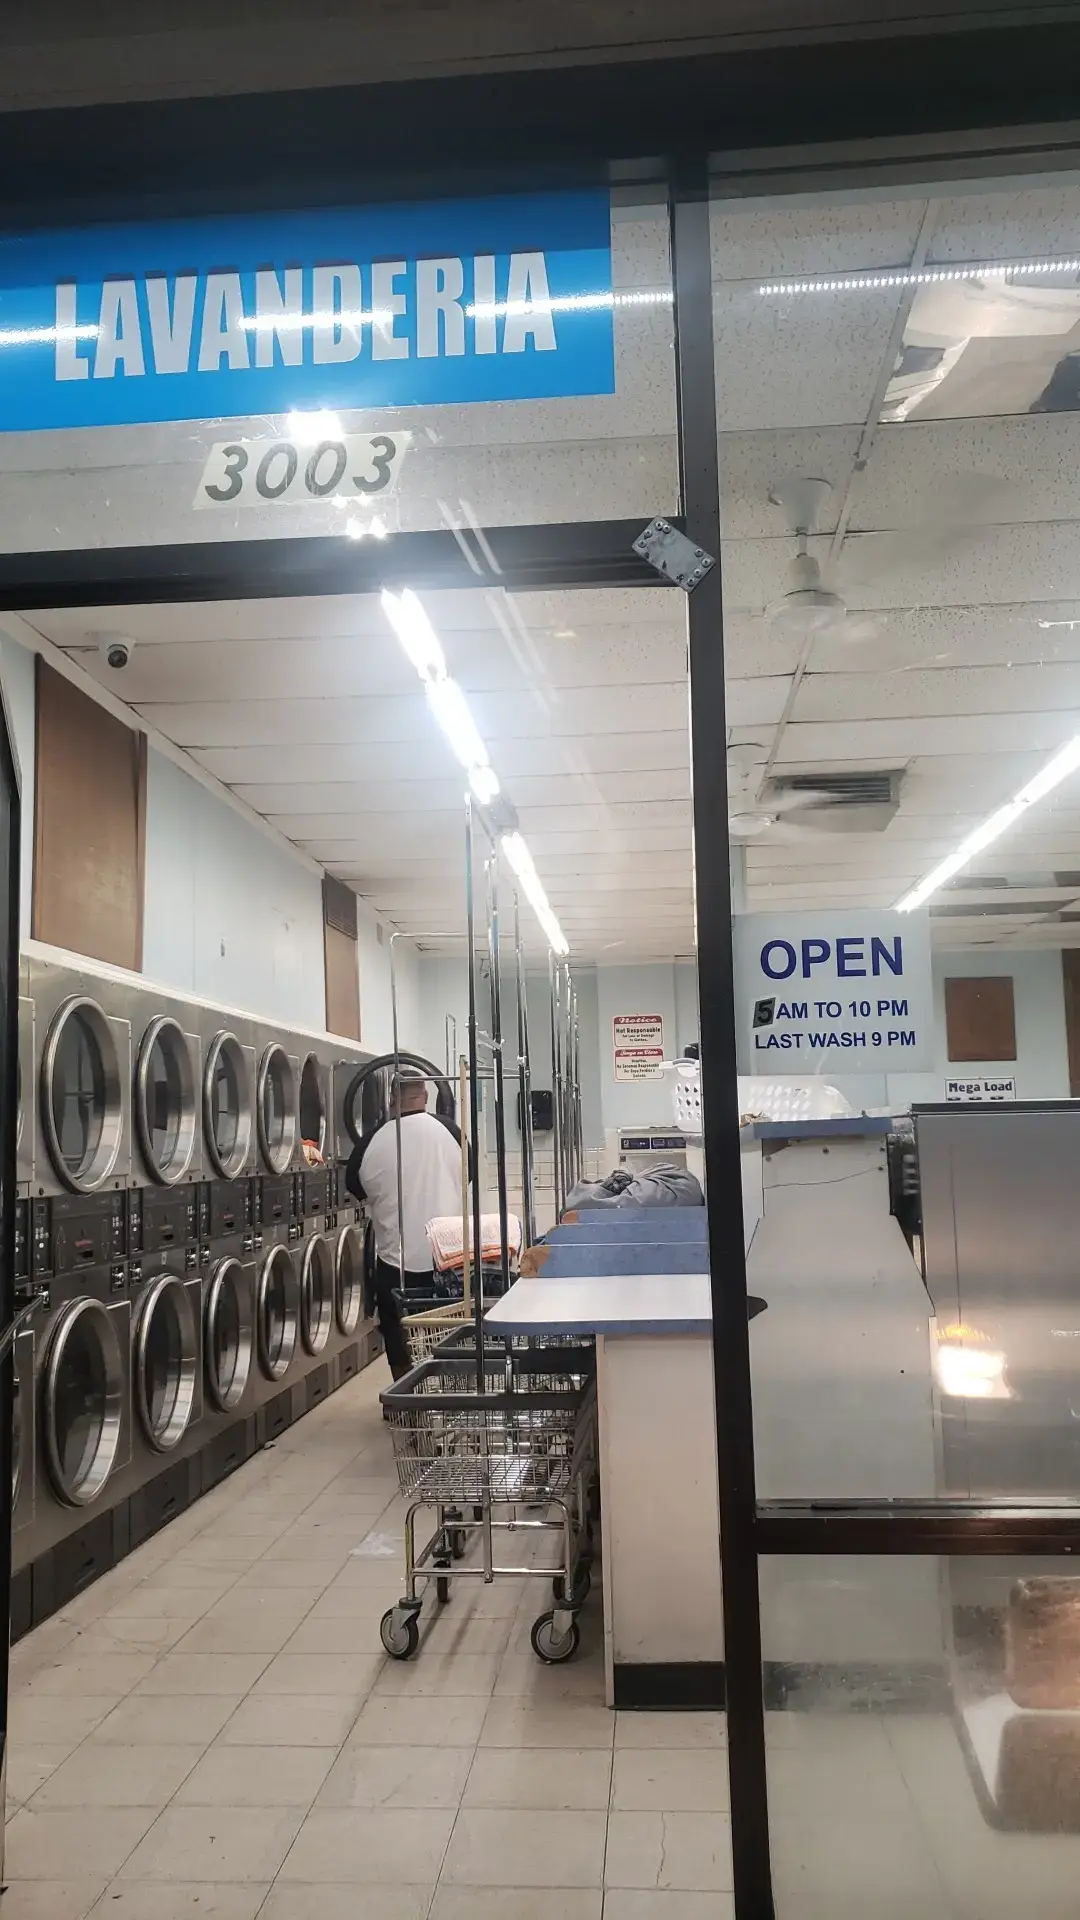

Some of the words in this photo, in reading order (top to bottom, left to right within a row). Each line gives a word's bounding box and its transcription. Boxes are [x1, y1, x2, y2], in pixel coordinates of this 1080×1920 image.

[55, 247, 557, 381] LAVANDERIA
[205, 435, 396, 501] 3003
[760, 936, 904, 980] OPEN
[814, 1001, 842, 1018] TO
[848, 1000, 871, 1017] 10
[877, 999, 909, 1017] PM
[755, 1033, 803, 1049] LAST
[808, 1031, 866, 1048] WASH
[871, 1031, 882, 1047] 9
[887, 1030, 916, 1046] PM
[949, 1082, 981, 1094] Mega
[984, 1081, 1012, 1091] Load
